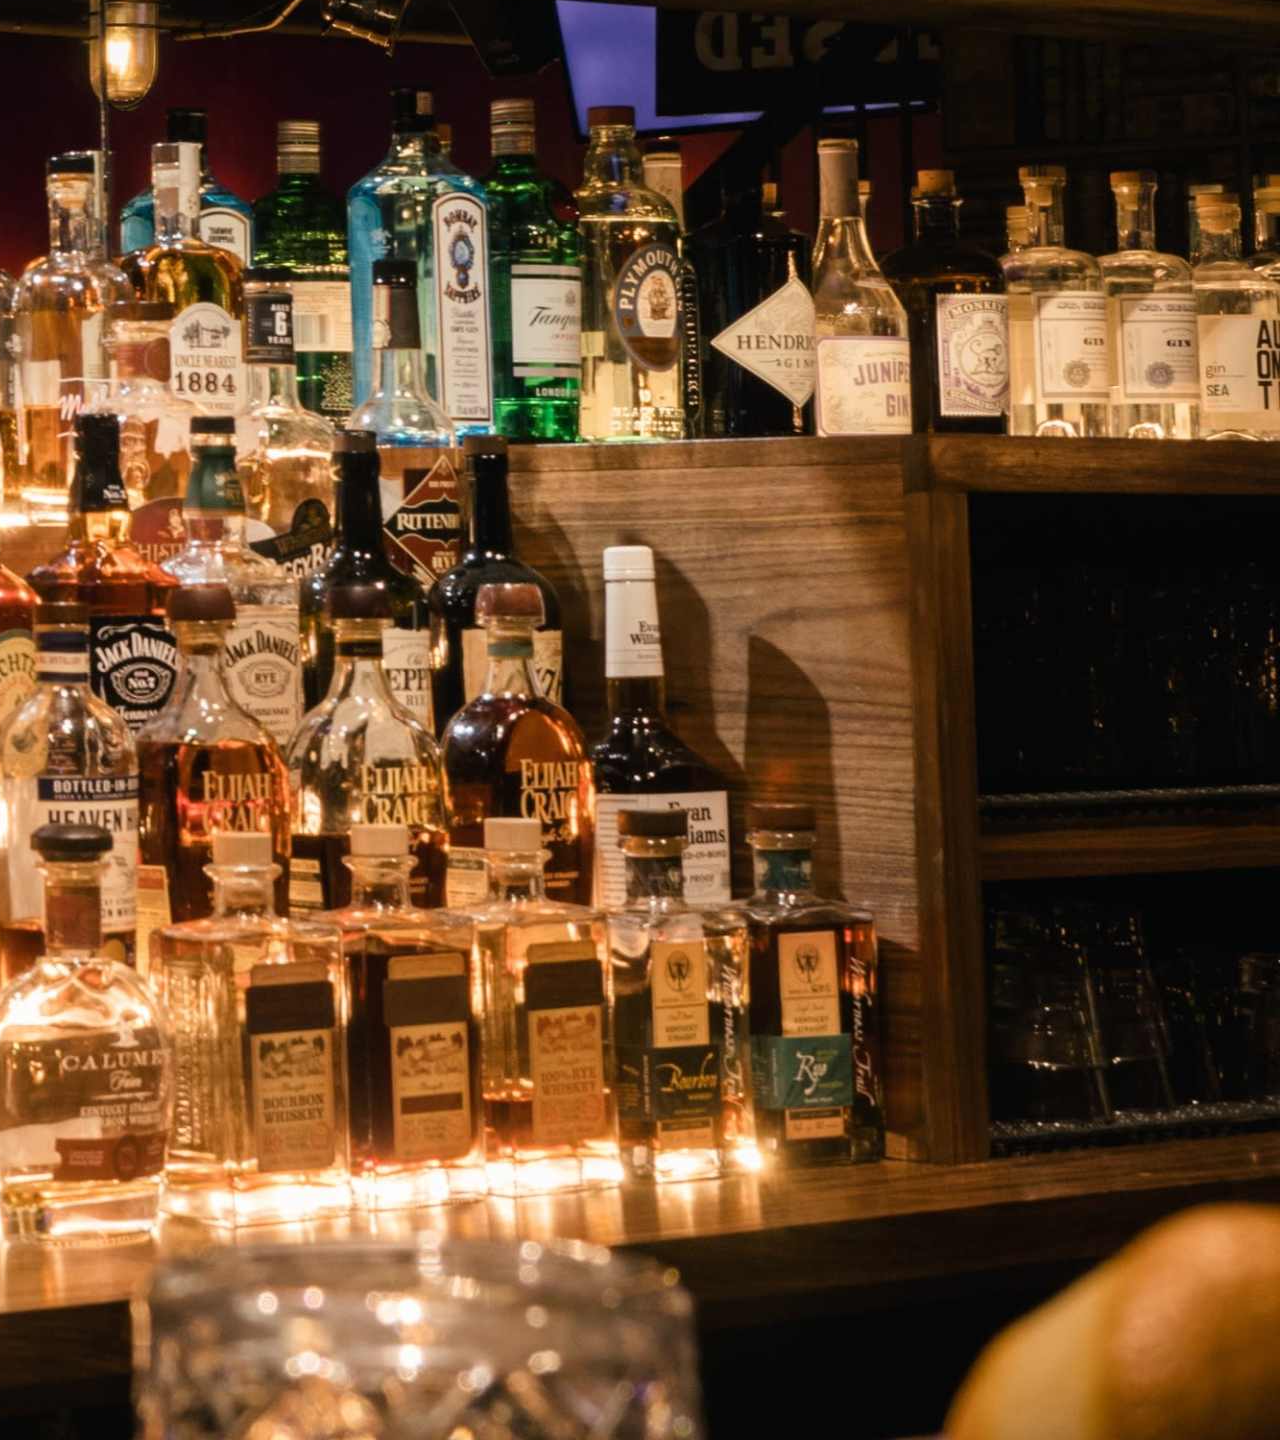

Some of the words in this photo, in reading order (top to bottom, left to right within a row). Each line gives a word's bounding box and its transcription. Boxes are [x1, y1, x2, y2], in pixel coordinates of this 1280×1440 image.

[618, 250, 678, 311] PLYMOUTH
[274, 311, 288, 336] 6
[736, 333, 815, 352] HENDRIC
[174, 371, 237, 394] 1884
[1205, 363, 1227, 378] gin
[1206, 385, 1230, 397] SEA
[95, 638, 132, 672] JACK
[225, 634, 256, 668] JACK
[254, 672, 278, 684] RYE
[202, 770, 272, 801] ELIJAH
[361, 764, 428, 794] ELIJAH
[519, 759, 579, 790] ELIJAH
[202, 800, 271, 833] CRAIG
[361, 793, 429, 826] CRAIG
[520, 789, 579, 823] CRAIG
[793, 1050, 829, 1096] Rye
[262, 1093, 325, 1109] BOURBON
[263, 1108, 325, 1124] WHISKEY
